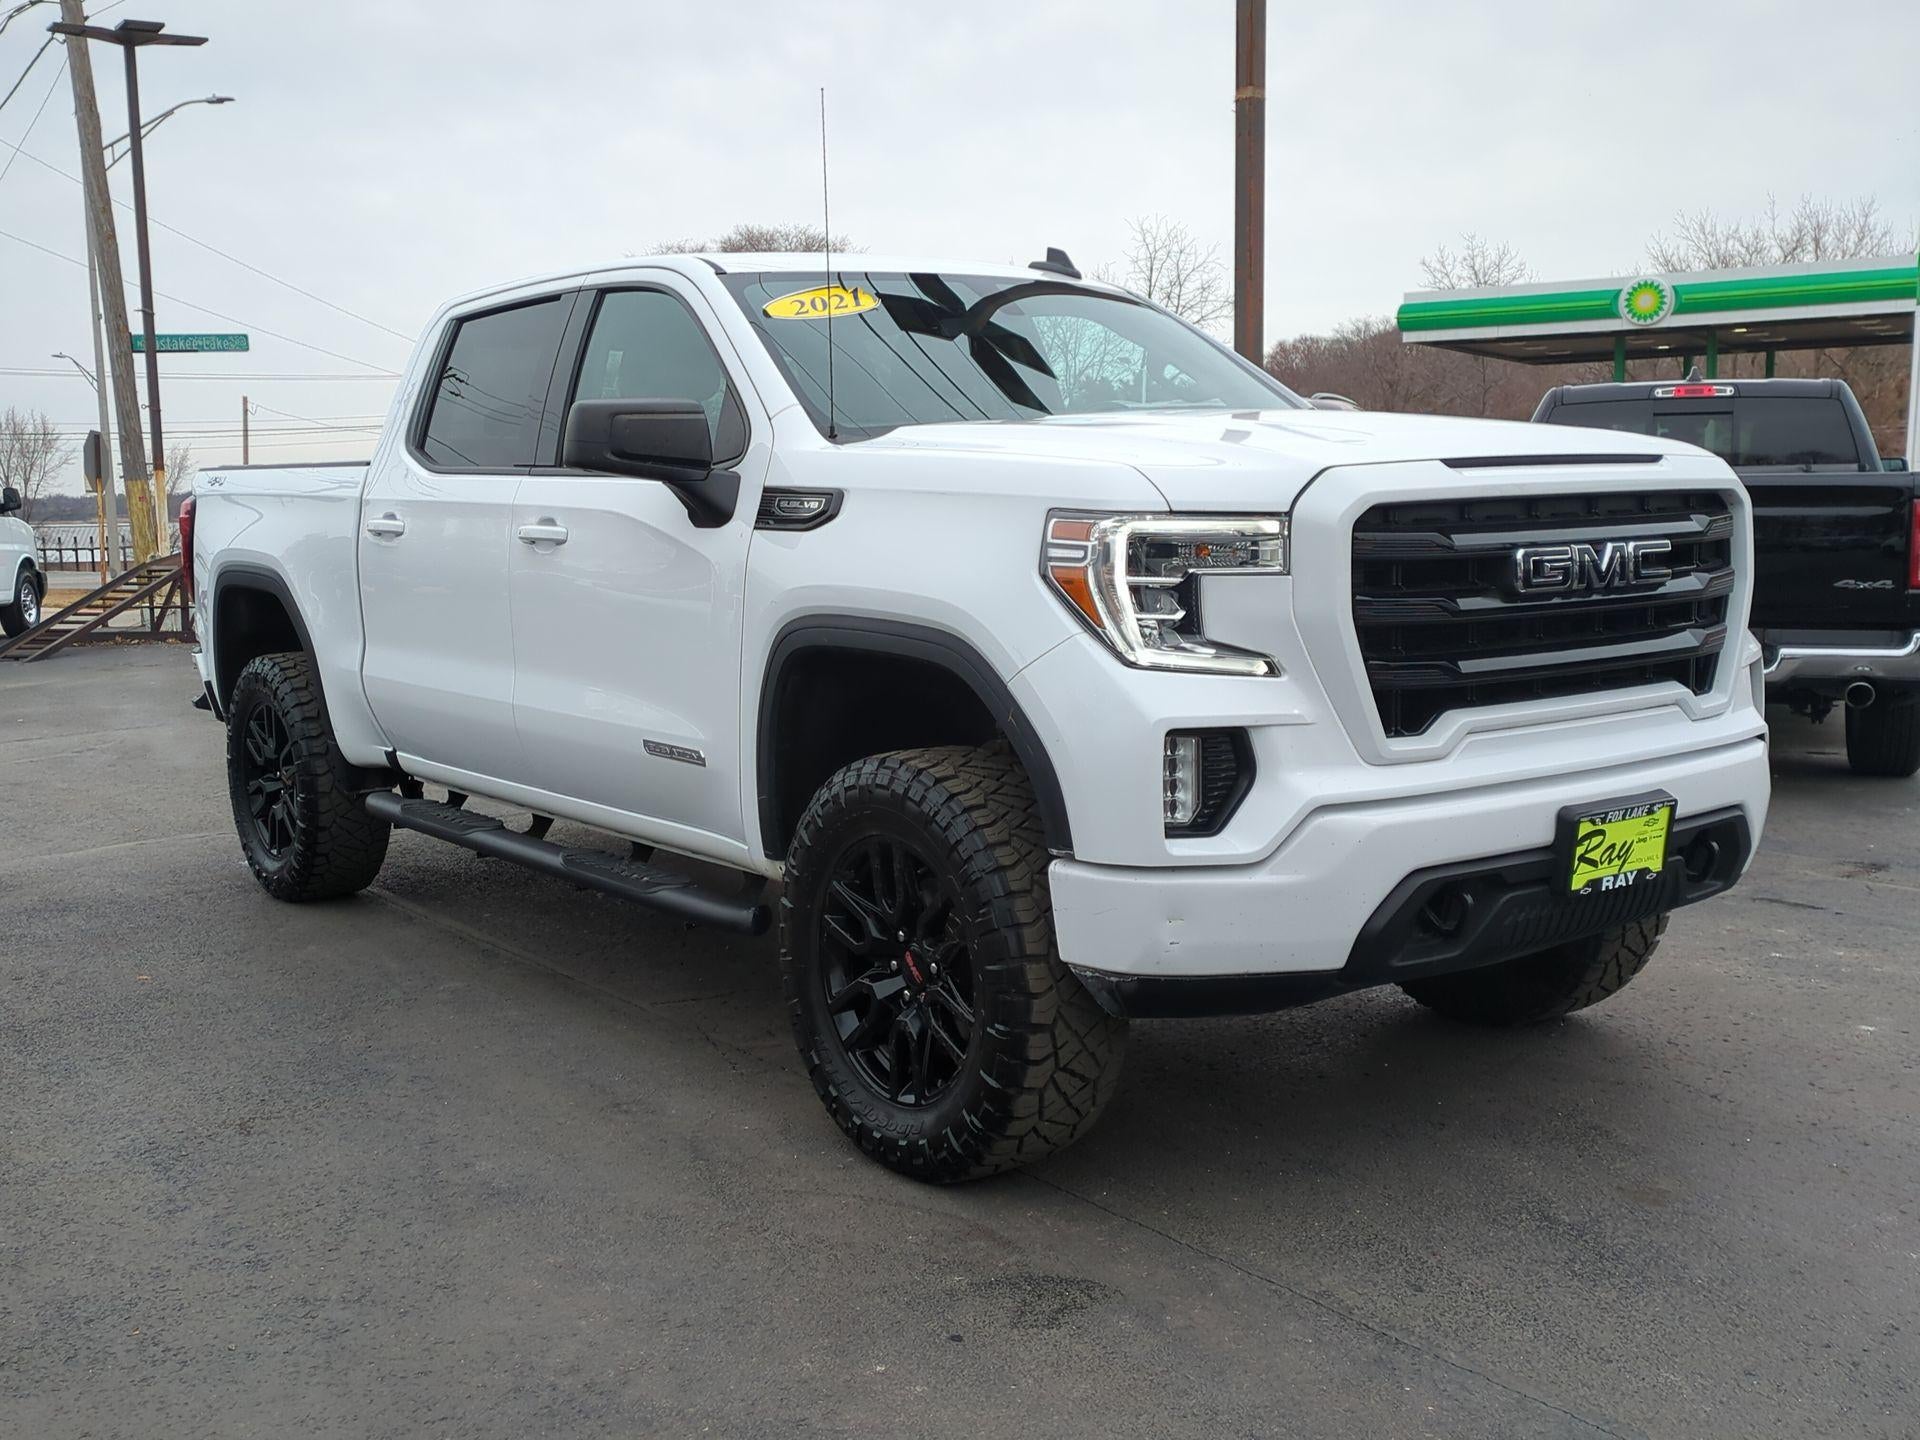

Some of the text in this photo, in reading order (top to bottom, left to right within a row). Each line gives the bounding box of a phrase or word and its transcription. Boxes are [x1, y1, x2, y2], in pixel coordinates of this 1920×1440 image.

[789, 286, 863, 316] 2021
[203, 336, 229, 351] Lake
[1515, 539, 1672, 593] GMC
[1605, 809, 1626, 824] FOX
[1625, 805, 1651, 819] LAKE
[1572, 828, 1635, 875] Ray
[1601, 870, 1638, 892] RAY
